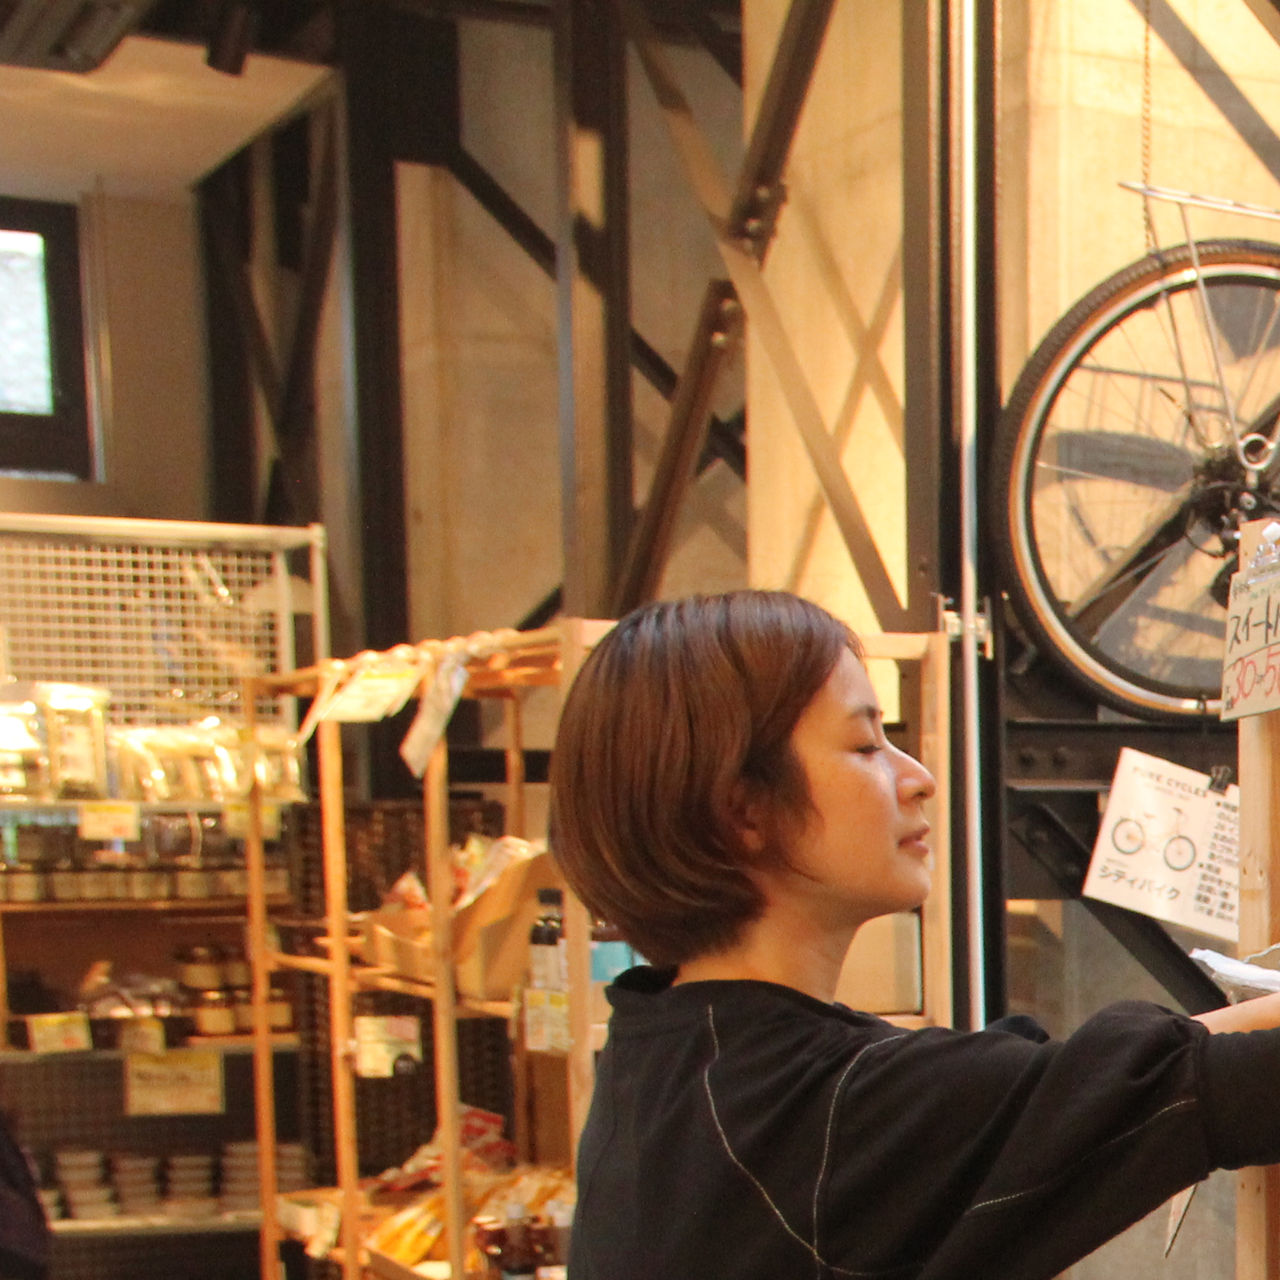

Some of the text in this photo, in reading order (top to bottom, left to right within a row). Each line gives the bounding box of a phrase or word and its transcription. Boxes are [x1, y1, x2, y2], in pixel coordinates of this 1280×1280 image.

[1098, 865, 1180, 901] シティバイク
